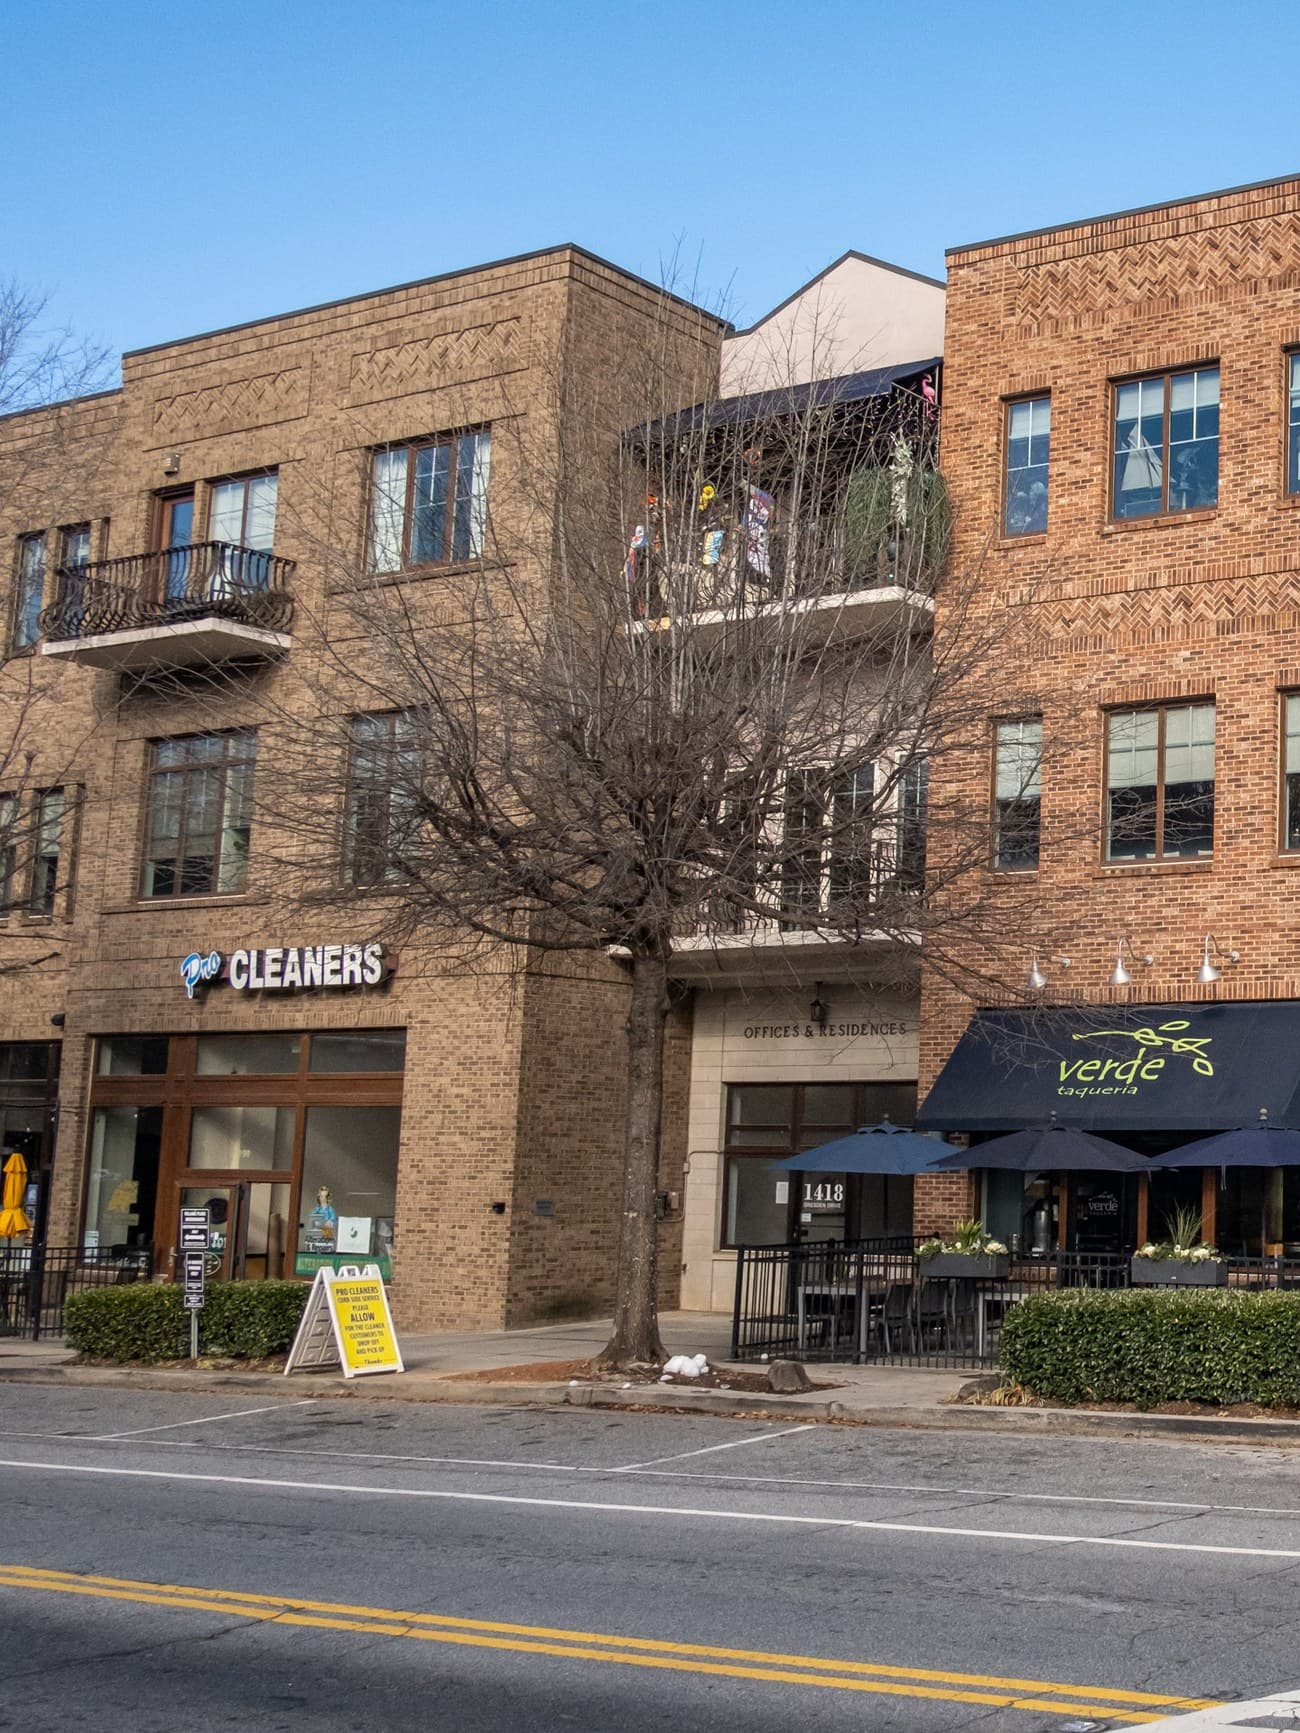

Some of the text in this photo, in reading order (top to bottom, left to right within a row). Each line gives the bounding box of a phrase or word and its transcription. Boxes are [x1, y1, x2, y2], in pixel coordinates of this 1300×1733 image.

[180, 943, 383, 999] Pro CLEANERS
[744, 1022, 906, 1039] OFFICES & RESIDENCES
[1059, 1047, 1165, 1085] verde
[1057, 1085, 1138, 1098] taqueria
[804, 1183, 844, 1202] 1418
[1088, 1199, 1119, 1211] verde
[350, 1286, 379, 1296] CLEANERS
[351, 1312, 375, 1323] ALLOW
